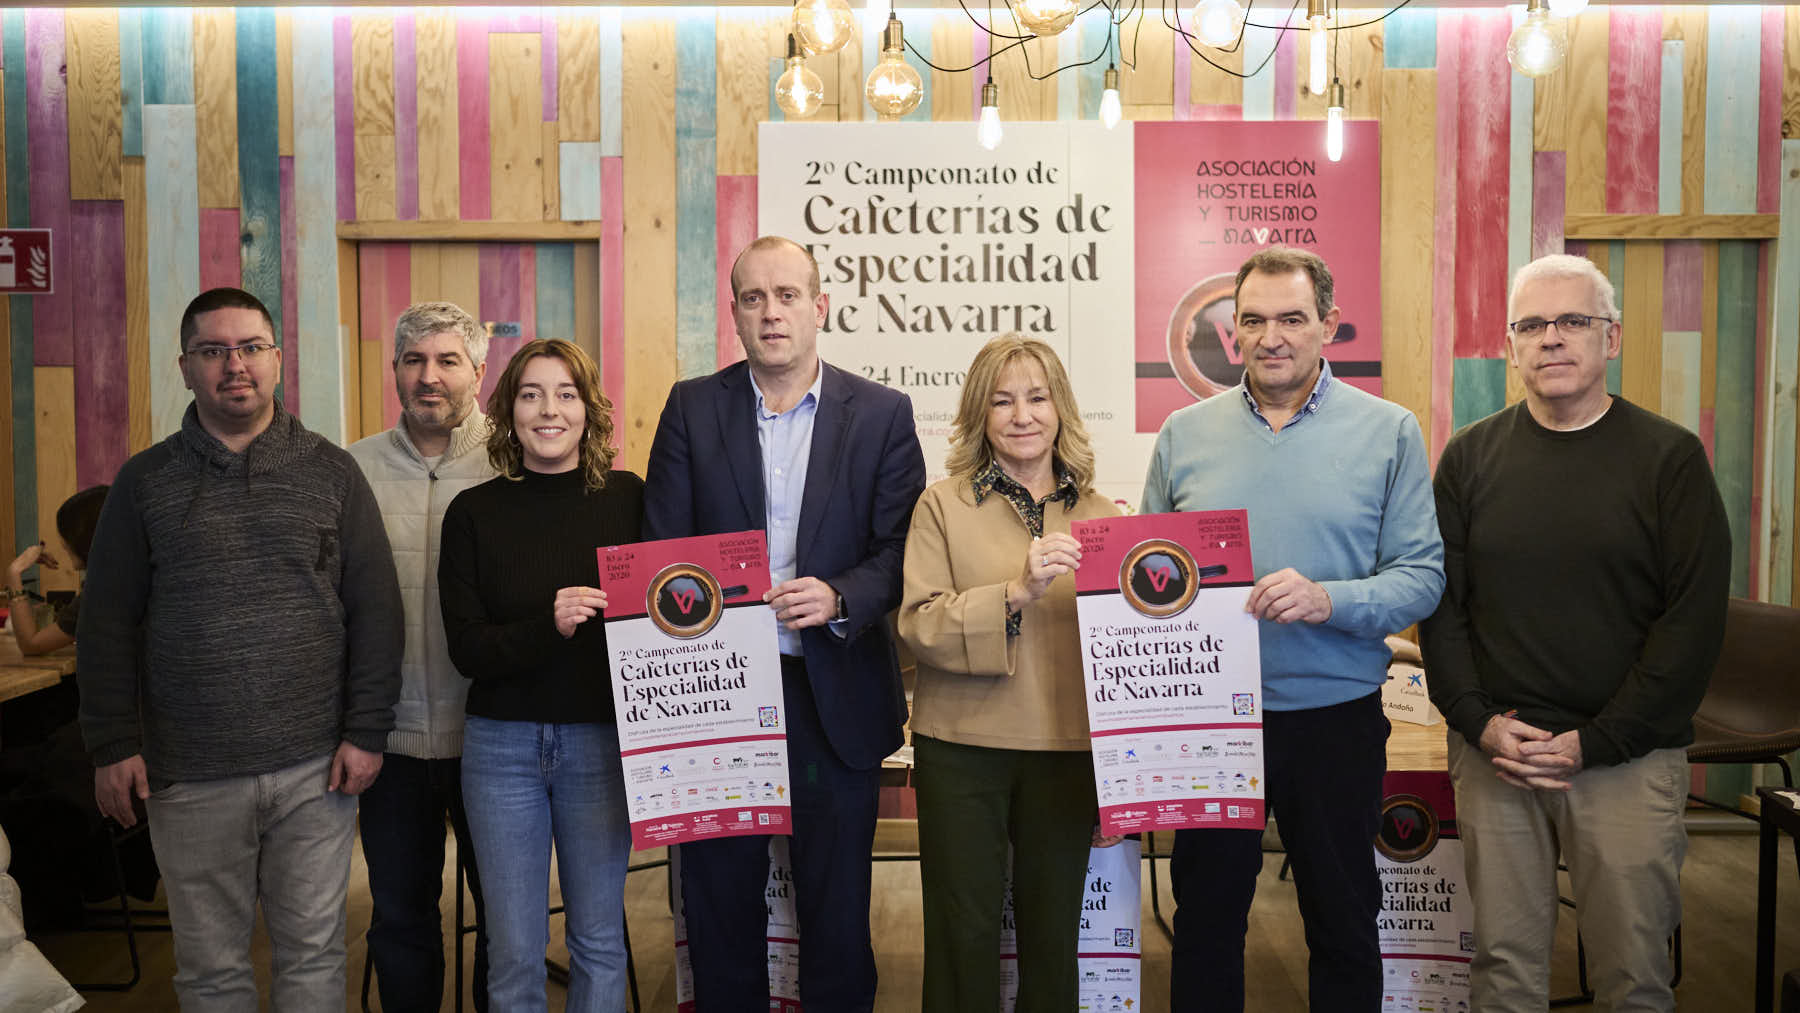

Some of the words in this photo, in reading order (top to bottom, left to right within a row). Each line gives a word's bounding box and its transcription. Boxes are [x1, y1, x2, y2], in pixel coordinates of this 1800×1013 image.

[804, 160, 835, 185] 2º
[845, 160, 1017, 193] Campeonato
[1026, 160, 1058, 184] de
[1196, 157, 1316, 177] ASOCIACIÓN
[1197, 181, 1318, 200] HOSTELERÍA
[804, 193, 1040, 235] Cafeterías
[1056, 193, 1113, 234] de
[1199, 206, 1211, 222] Y
[1225, 206, 1318, 222] TURISMO
[806, 241, 1100, 298] Especialidad
[876, 294, 1057, 333] Navarra
[900, 366, 966, 387] Enero
[1106, 621, 1182, 638] Campeonato
[1185, 620, 1200, 632] de
[635, 642, 709, 660] Campeonato
[711, 639, 726, 650] de
[1091, 636, 1193, 659] Cafeterías
[1199, 634, 1225, 653] de
[620, 656, 720, 682] Cafeterías
[726, 652, 750, 670] de
[1093, 655, 1221, 685] Especialidad
[623, 671, 747, 705] Especialidad
[1095, 684, 1118, 703] de
[1124, 681, 1204, 701] Navarra
[626, 704, 649, 723] de
[655, 698, 732, 719] Navarra
[1377, 866, 1420, 876] peonato
[1423, 865, 1438, 876] de
[1090, 877, 1113, 893] de
[1384, 877, 1429, 894] erías
[1434, 878, 1458, 894] de
[1380, 895, 1453, 913] cialidad
[1378, 918, 1436, 931] avarra
